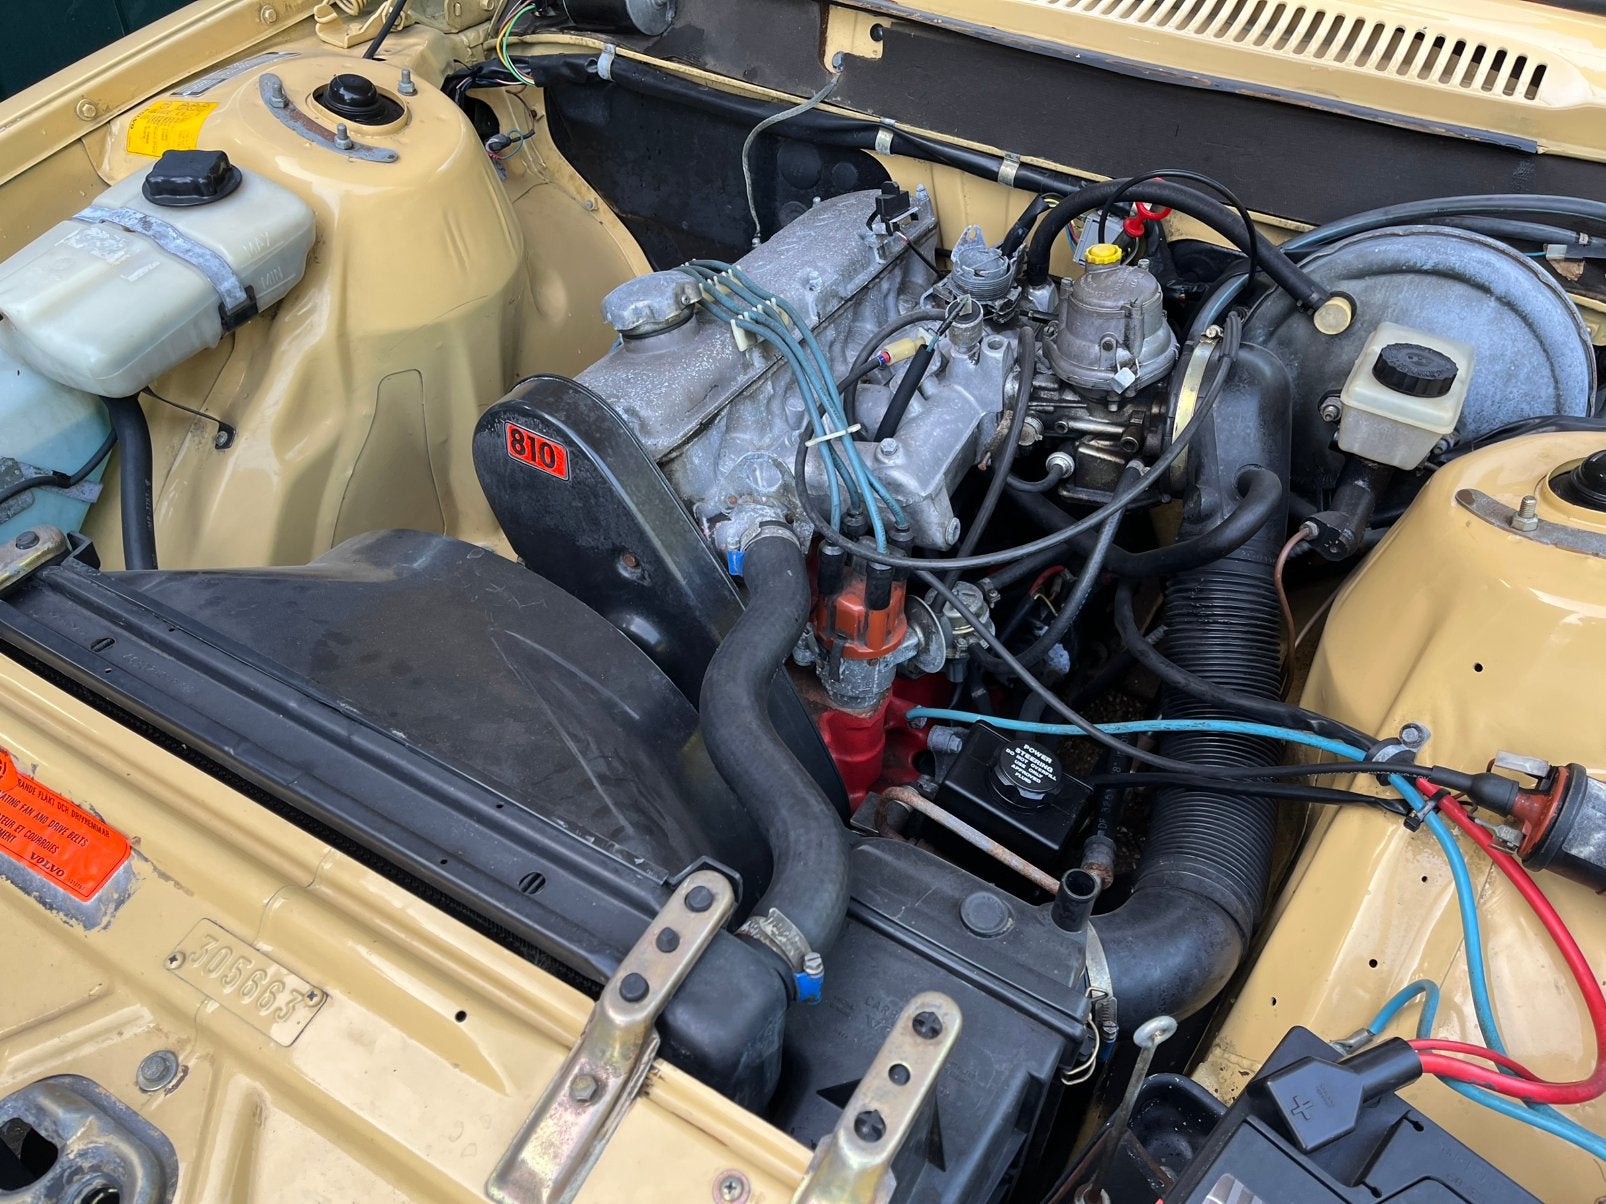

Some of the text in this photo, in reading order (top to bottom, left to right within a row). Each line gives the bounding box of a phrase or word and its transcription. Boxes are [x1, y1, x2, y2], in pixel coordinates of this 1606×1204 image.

[510, 428, 556, 469] 810
[1015, 747, 1054, 773] STEERING
[1023, 744, 1052, 763] POWER
[1010, 764, 1042, 784] APPROVED
[1014, 760, 1043, 778] USE ONLY
[1015, 772, 1031, 783] FLUID
[1016, 755, 1028, 763] NOT
[1030, 763, 1057, 781] OVERFILL
[0, 790, 89, 848] ATING FAN AND DRIVE BELTS
[57, 801, 70, 815] OCH
[0, 812, 60, 854] TEUR ET COURROIES
[30, 851, 65, 877] VOLVO
[189, 933, 305, 1023] 305663
